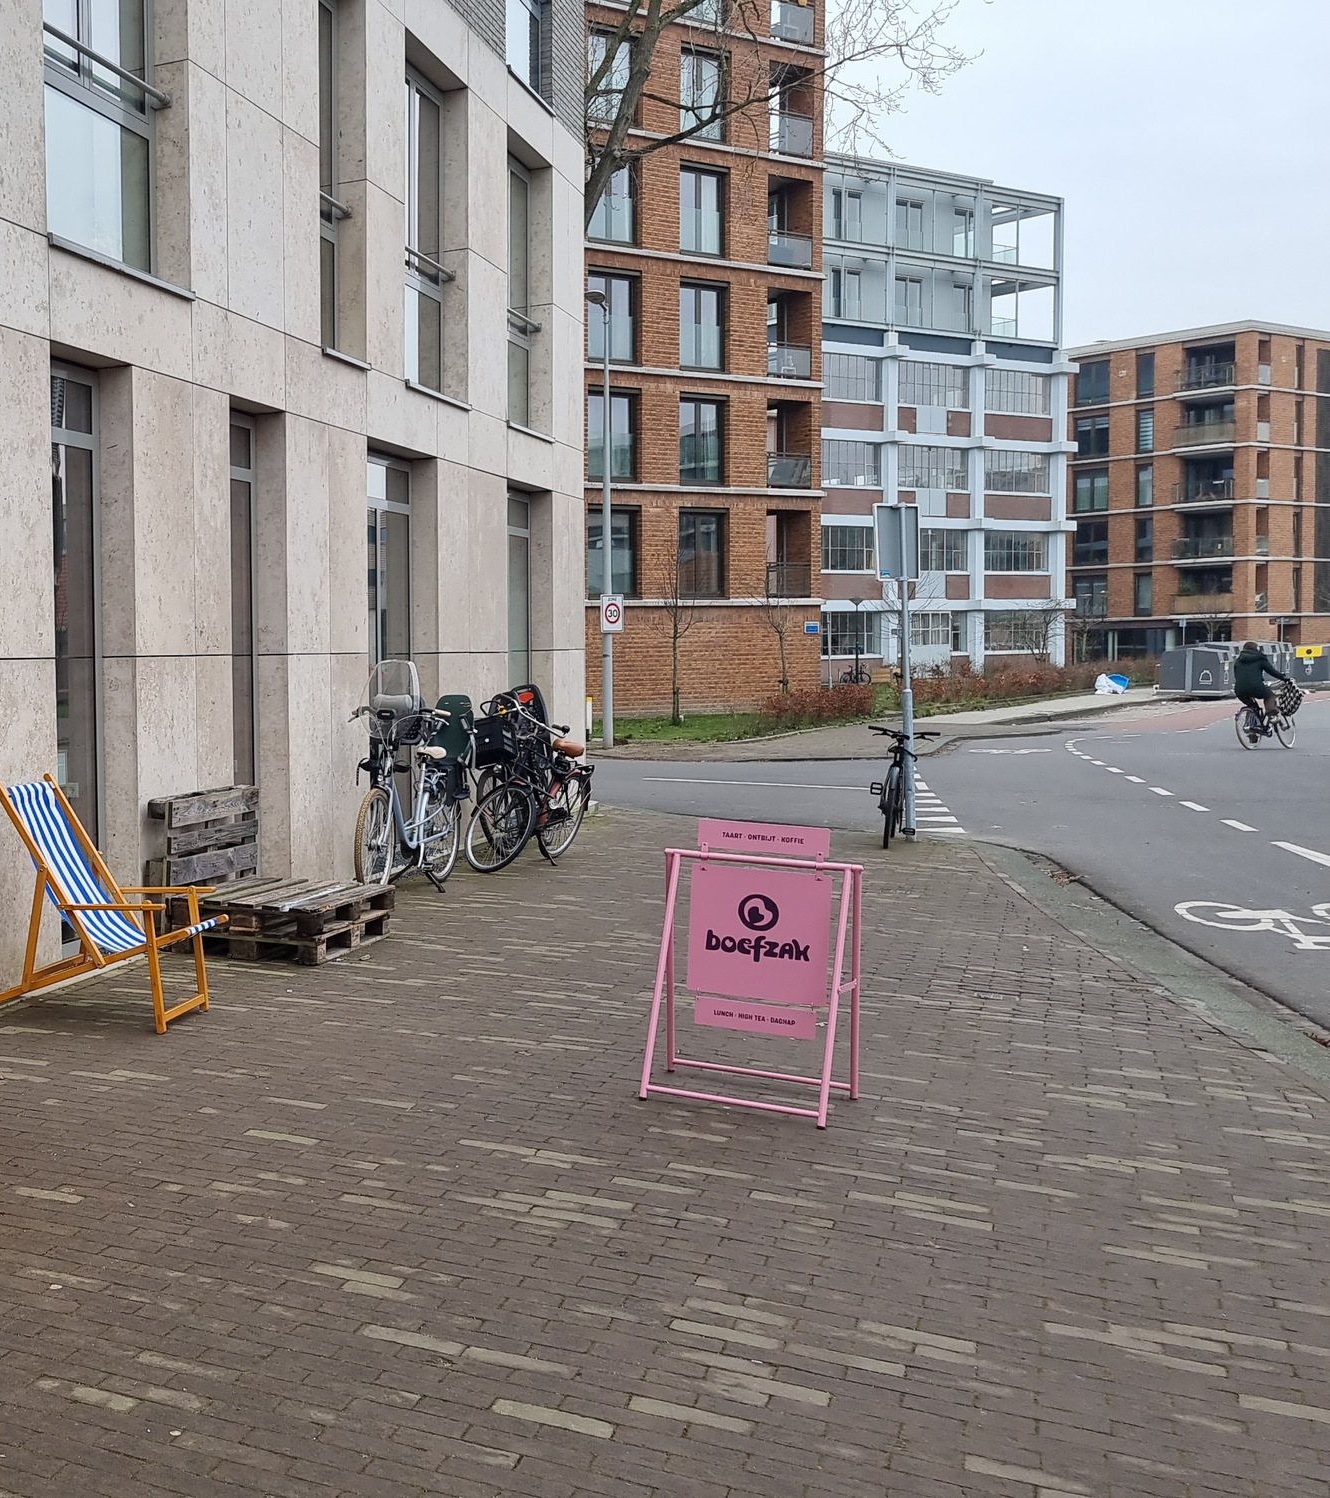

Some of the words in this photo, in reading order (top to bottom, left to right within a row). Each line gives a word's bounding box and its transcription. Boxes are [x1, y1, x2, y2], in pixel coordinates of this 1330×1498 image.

[608, 609, 618, 618] 30
[722, 831, 743, 839] TAART
[747, 833, 776, 842] ONTBIJT
[781, 836, 805, 845] KOFFIE
[713, 1009, 734, 1018] LUNCH
[738, 1012, 753, 1020] HIGH
[754, 1014, 766, 1022] TEA
